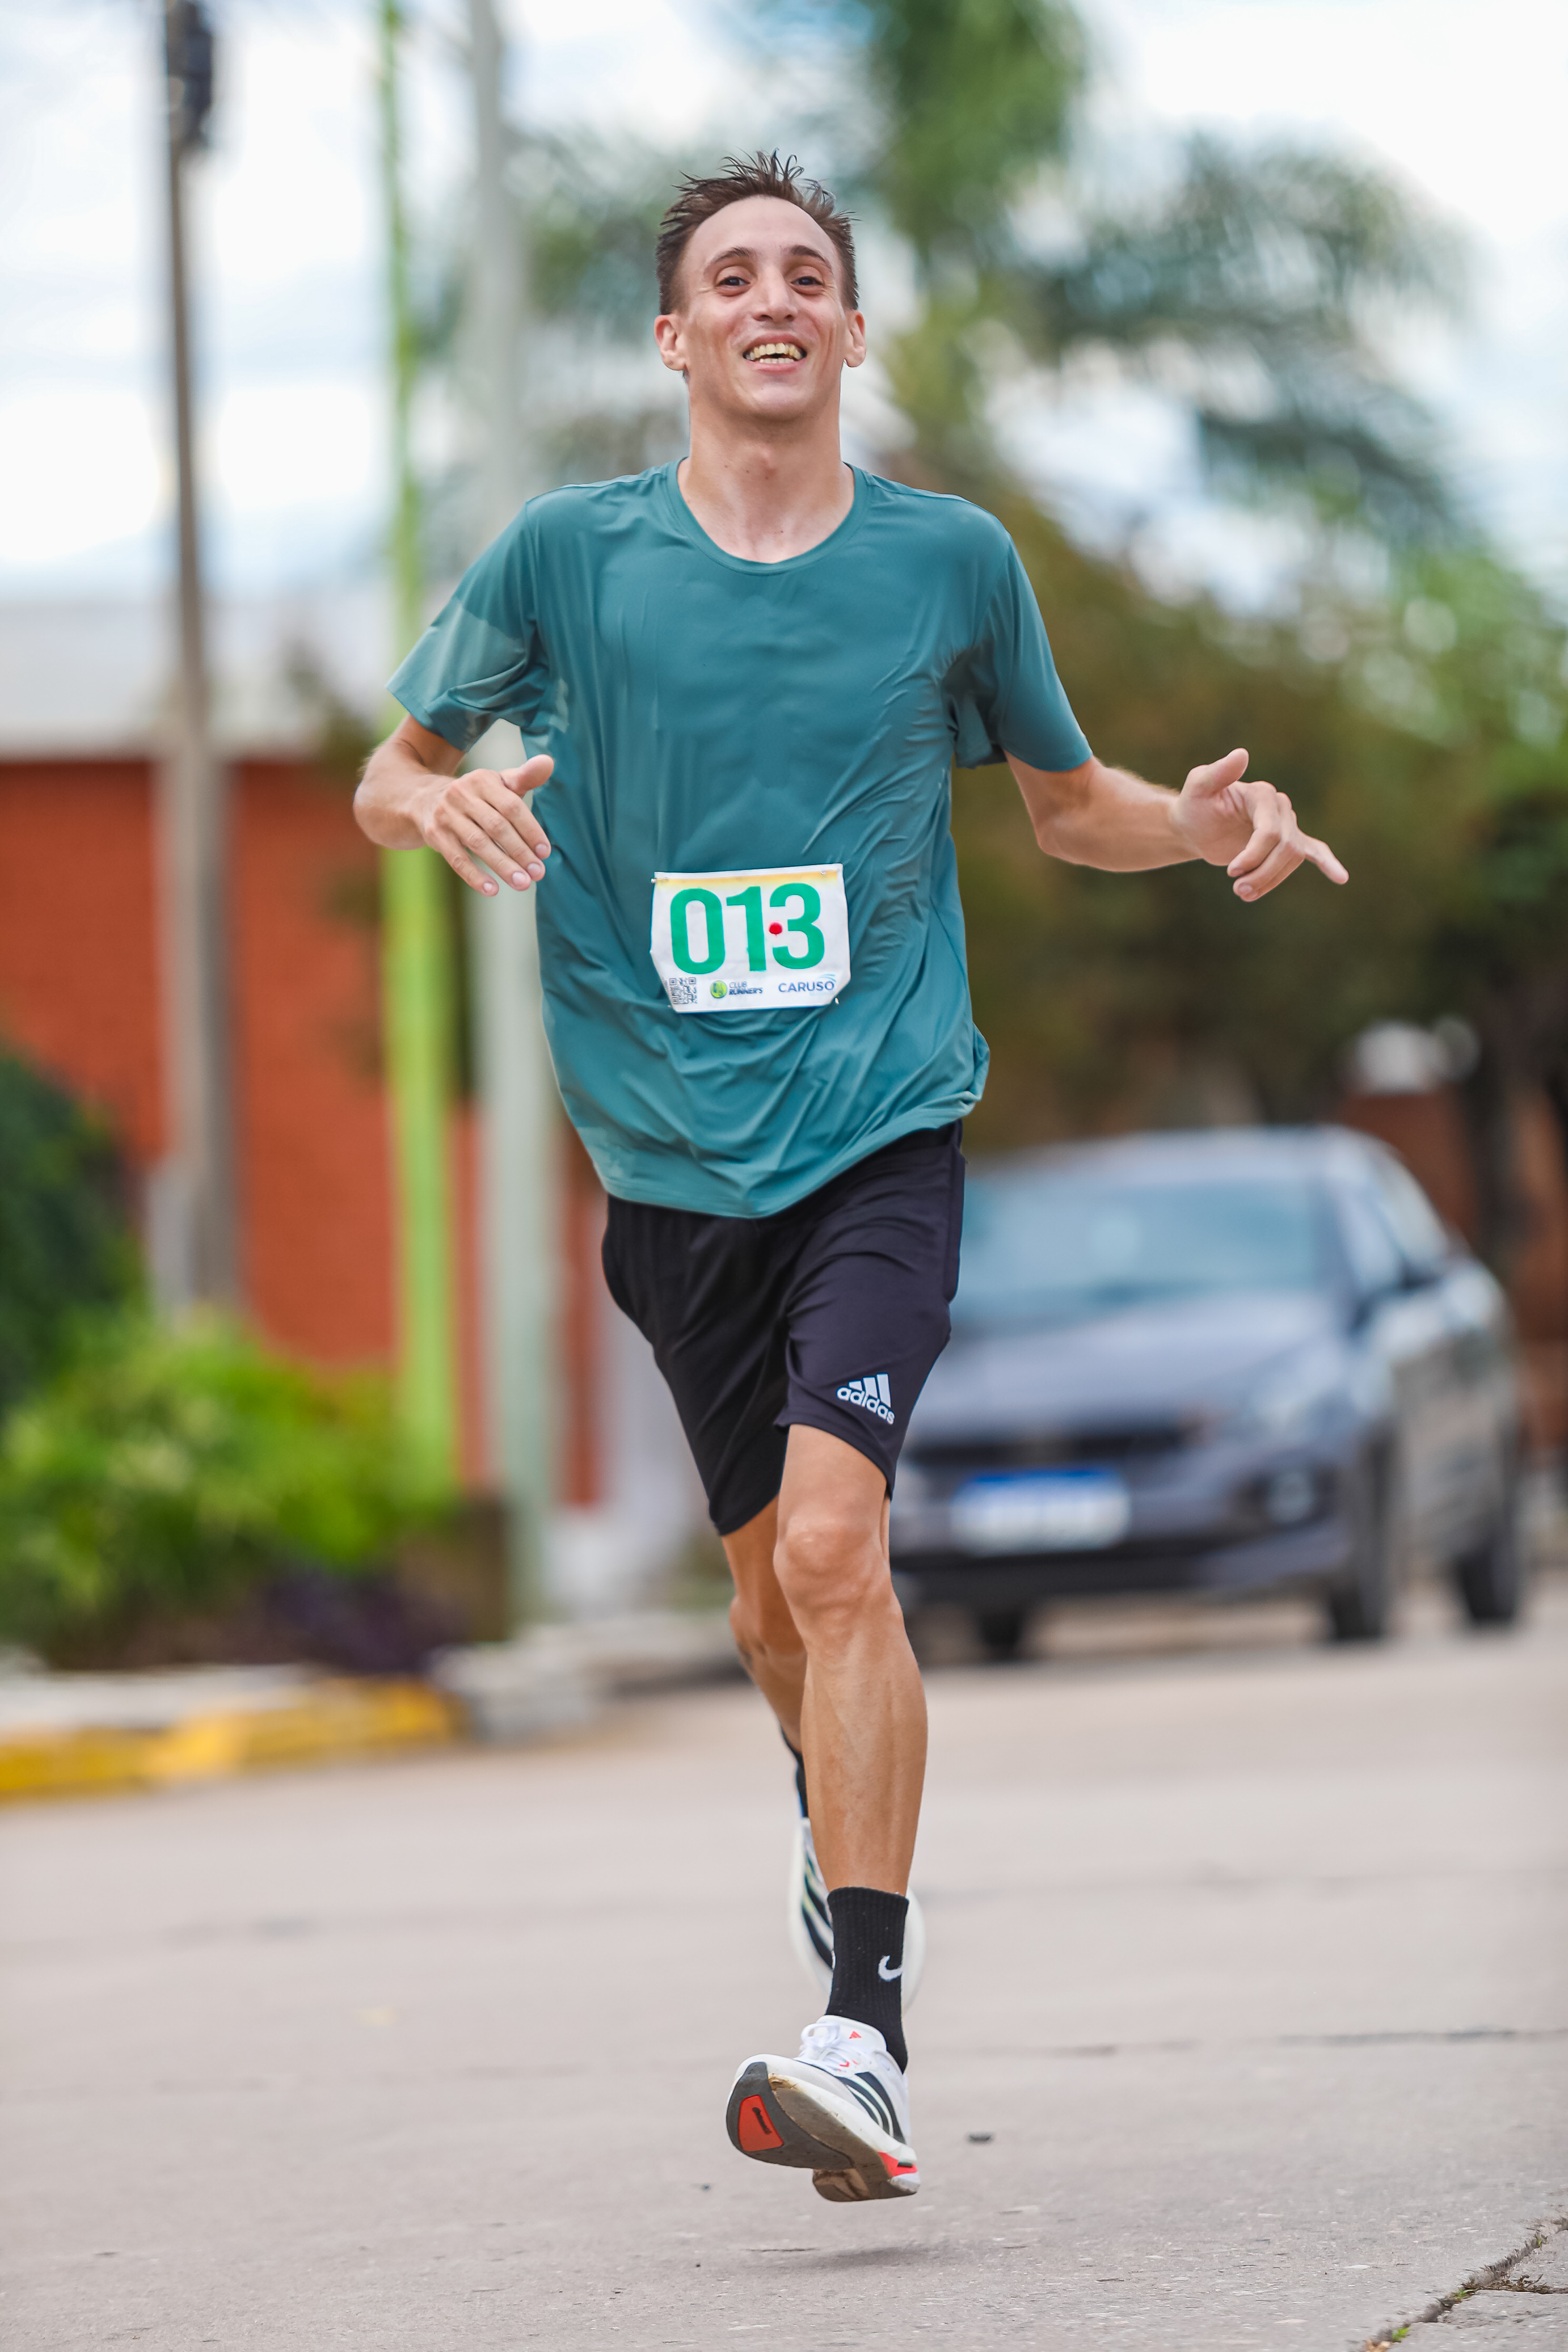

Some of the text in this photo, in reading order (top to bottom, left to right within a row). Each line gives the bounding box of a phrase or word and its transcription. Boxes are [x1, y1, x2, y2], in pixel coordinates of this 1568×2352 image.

[670, 883, 825, 975] 013
[778, 981, 835, 993] CARUSO
[837, 1387, 895, 1425] adidas
